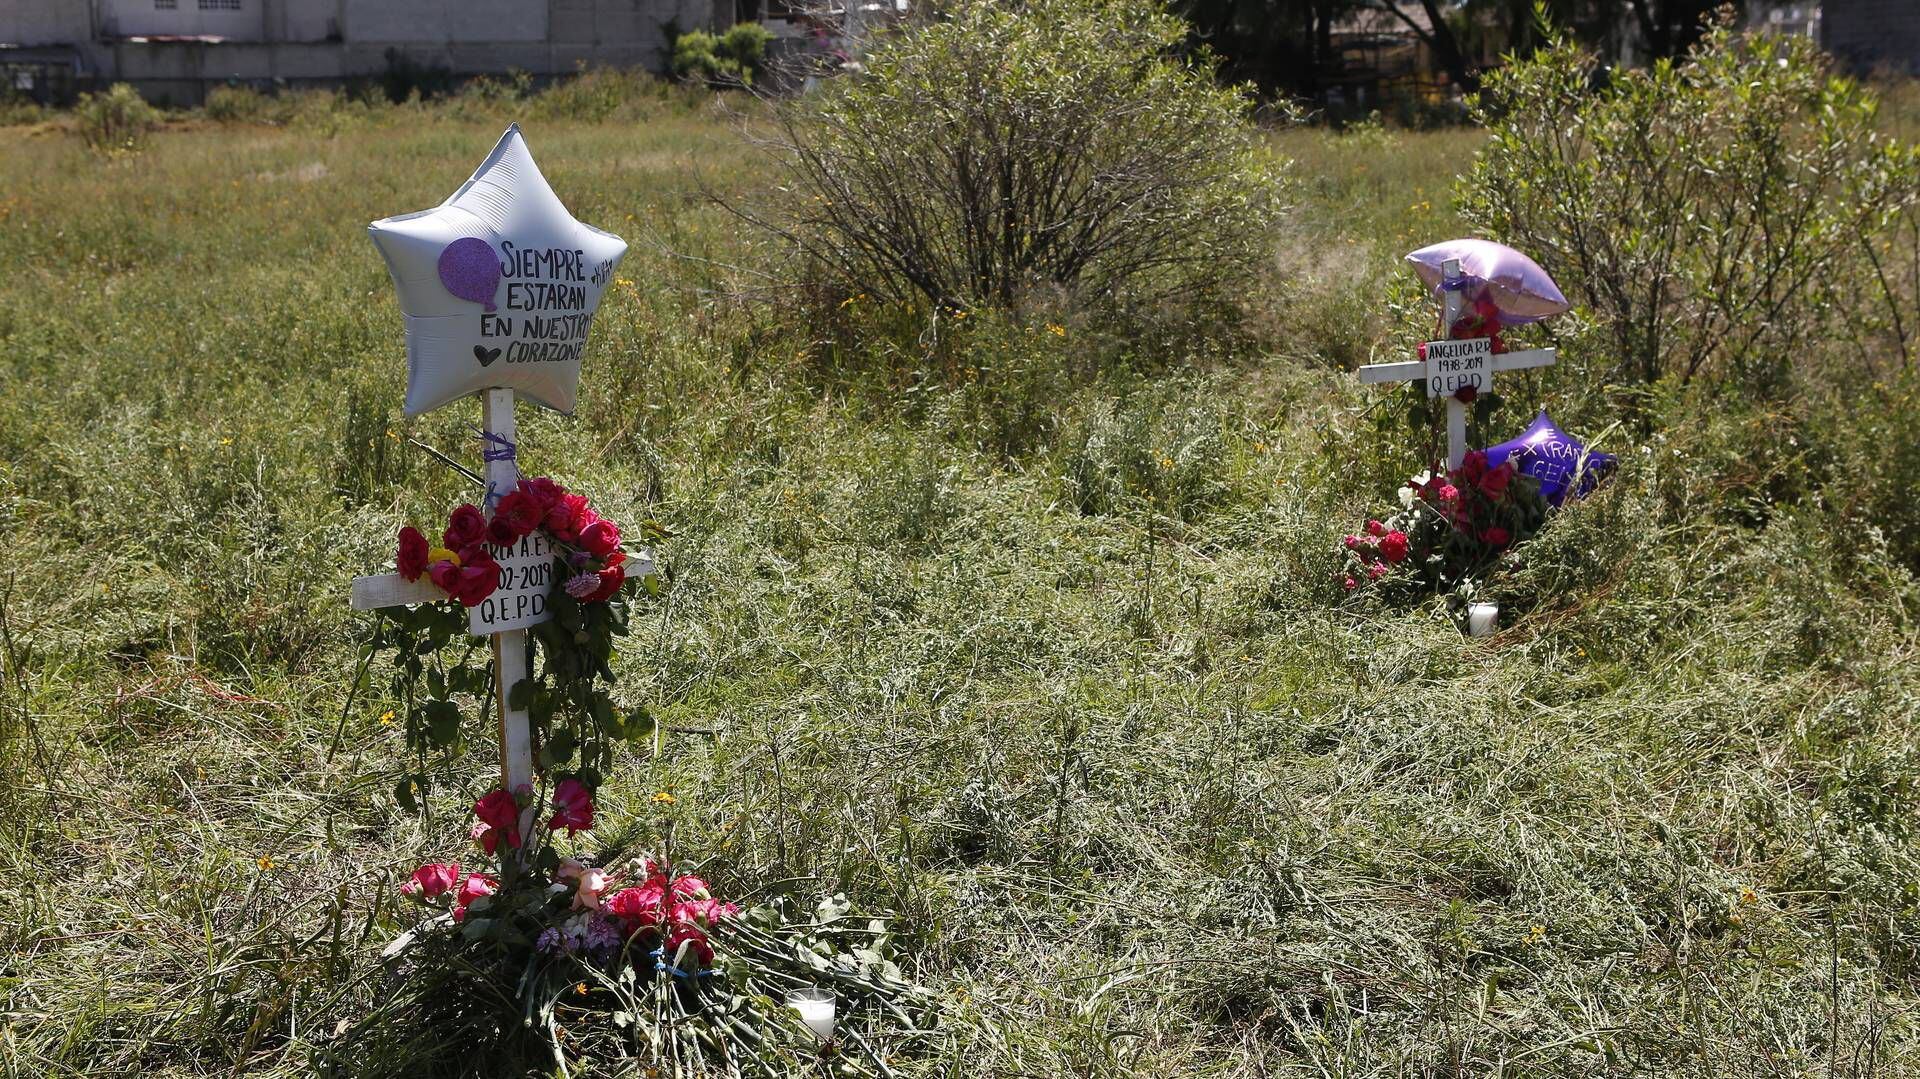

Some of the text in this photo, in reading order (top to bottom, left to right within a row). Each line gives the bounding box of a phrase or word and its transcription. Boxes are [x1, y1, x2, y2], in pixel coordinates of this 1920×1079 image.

[500, 240, 585, 281] SIEMPRE
[507, 283, 586, 311] ESTARAN
[481, 314, 512, 337] EN
[1429, 343, 1473, 360] ANGELICA
